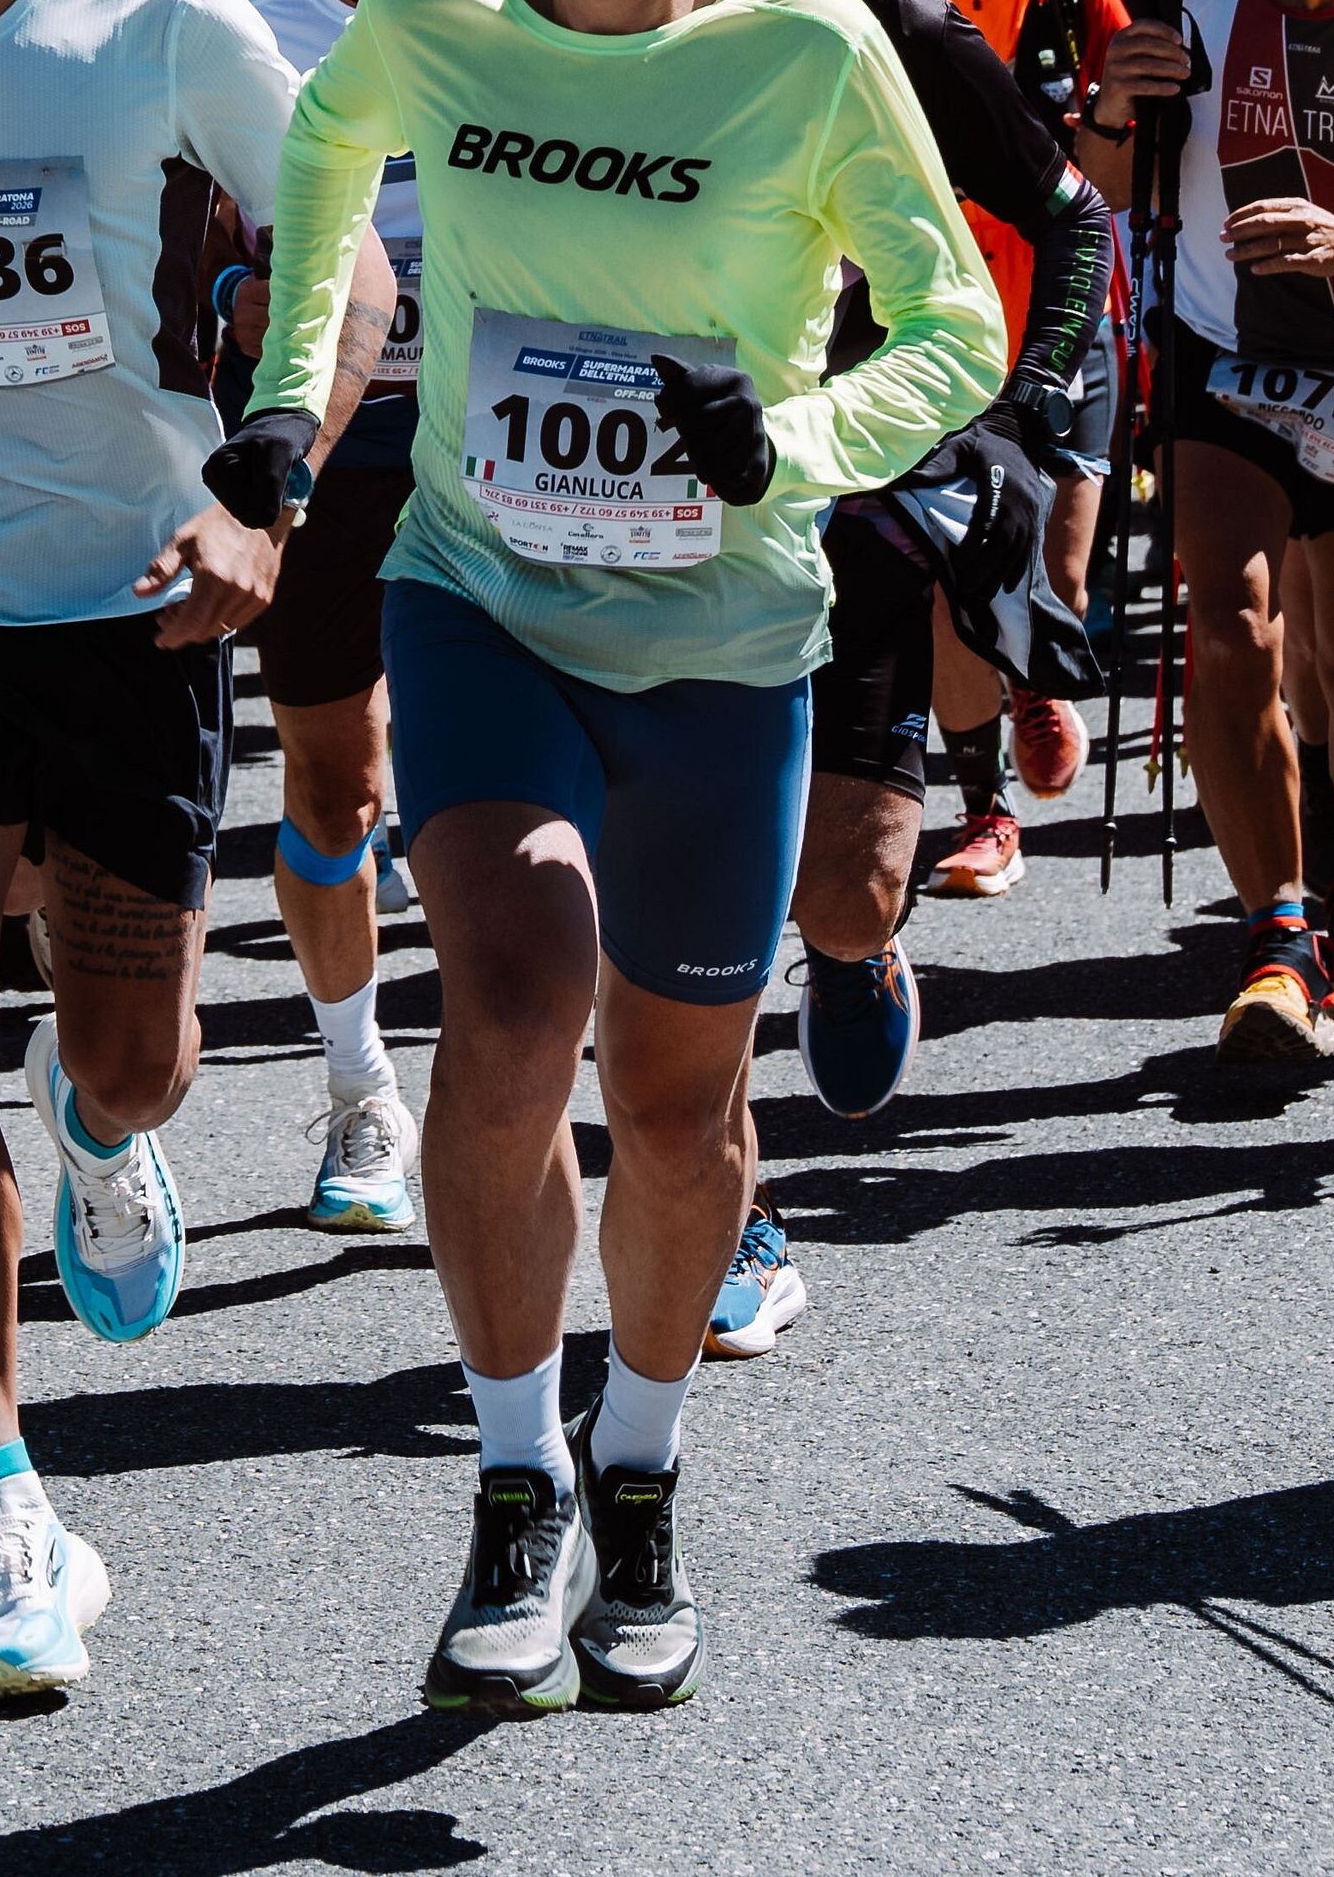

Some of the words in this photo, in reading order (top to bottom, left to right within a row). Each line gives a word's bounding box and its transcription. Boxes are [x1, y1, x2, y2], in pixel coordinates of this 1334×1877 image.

[1227, 99, 1289, 138] ETNA
[447, 123, 712, 203] BROOKS
[11, 200, 33, 211] 2026
[1127, 277, 1141, 341] CAMP
[522, 355, 567, 370] BROOKS
[582, 360, 660, 377] SUPERMARAT
[579, 369, 635, 384] DELL'ETNA
[651, 376, 665, 386] 20
[614, 388, 655, 401] OFF-RO
[535, 472, 644, 500] GIANLUCA
[677, 958, 758, 976] BROOKS
